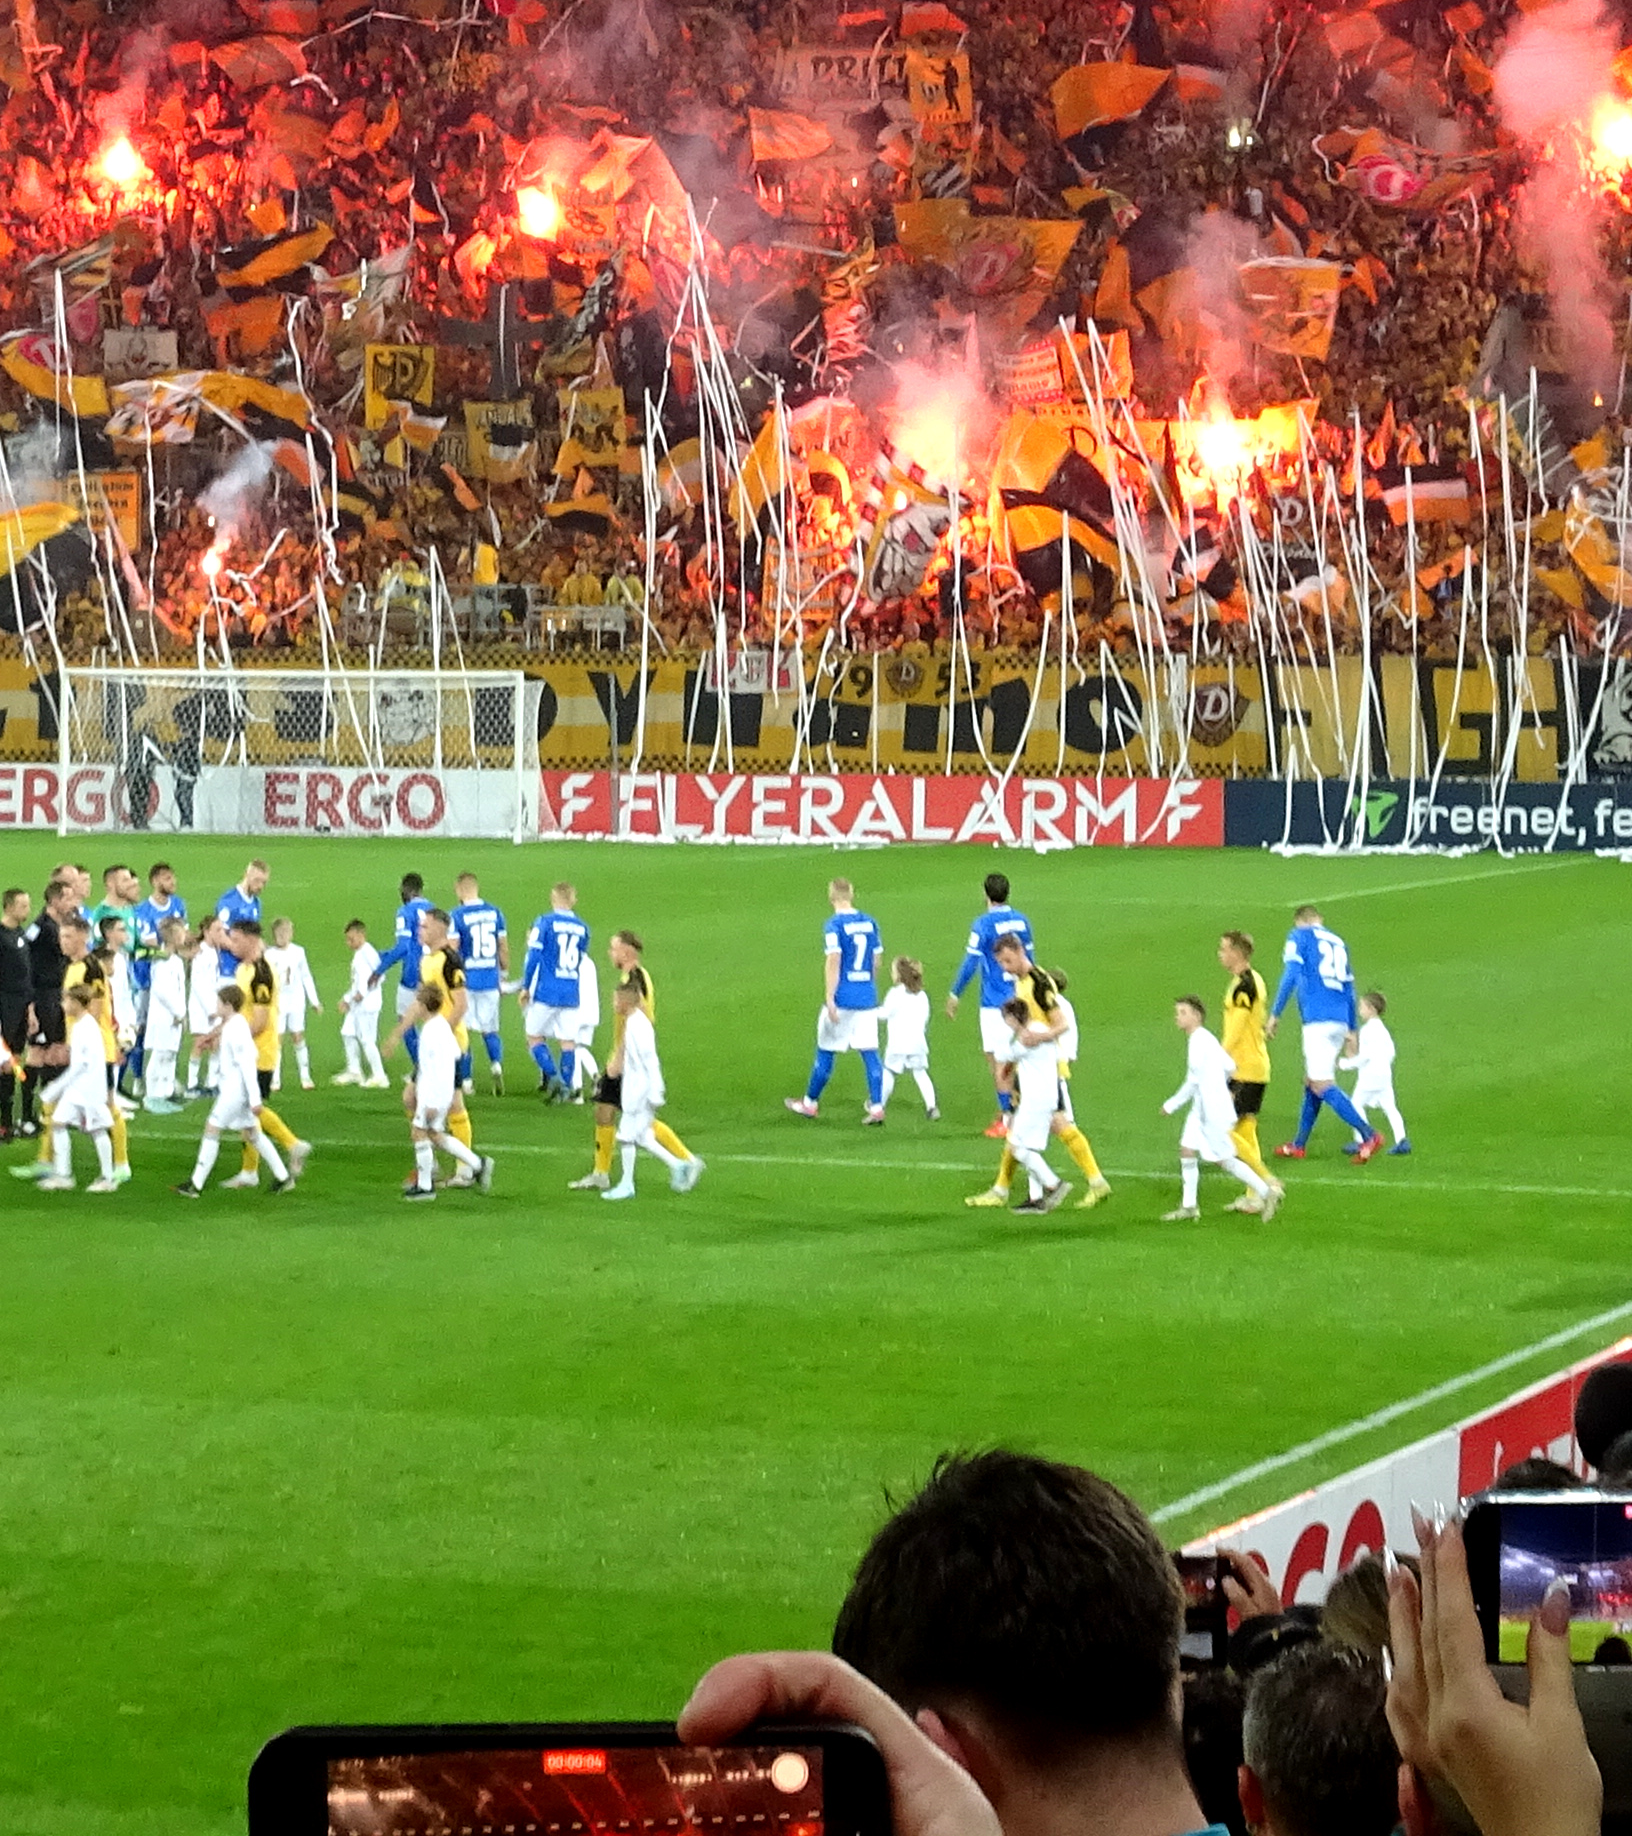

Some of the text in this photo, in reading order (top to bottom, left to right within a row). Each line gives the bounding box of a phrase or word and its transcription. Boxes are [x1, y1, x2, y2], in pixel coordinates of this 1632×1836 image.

[264, 771, 446, 831] ERGO
[619, 774, 1137, 844] FLYERALARM
[470, 921, 497, 958] 15
[557, 933, 580, 970] 16
[1318, 939, 1348, 983] 20
